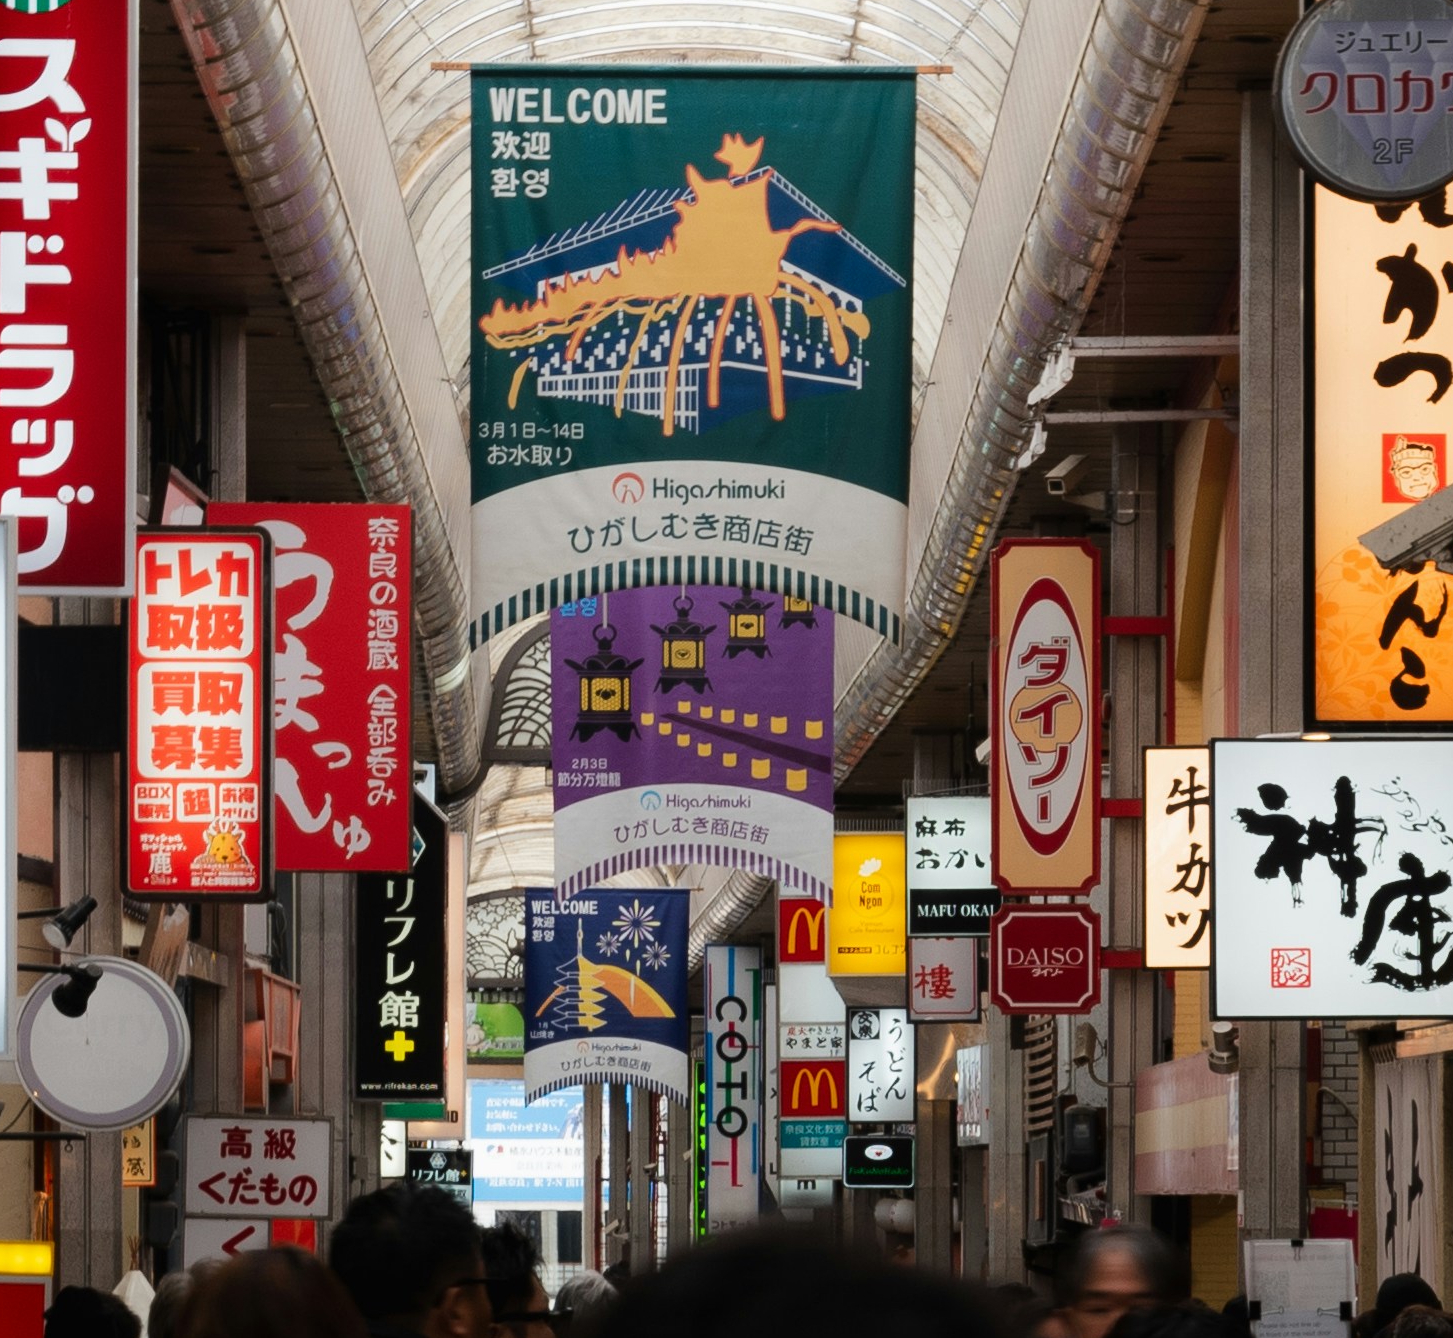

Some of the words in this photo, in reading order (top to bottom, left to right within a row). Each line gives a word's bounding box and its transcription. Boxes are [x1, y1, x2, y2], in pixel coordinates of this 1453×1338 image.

[1334, 30, 1449, 56] ジュエリー
[490, 88, 668, 124] WELCOME
[491, 131, 551, 161] 欢迎
[1372, 138, 1415, 165] 2F
[490, 167, 550, 199] 환영
[486, 443, 574, 467] お水取り
[652, 478, 786, 506] Higashimuki
[566, 512, 815, 558] ひがしむき商店街
[144, 549, 250, 598] トレカ
[367, 516, 400, 671] 奈良の酒蔵
[146, 604, 244, 651] 取扱
[151, 671, 244, 717] 買取
[1016, 636, 1074, 824] ダイソー
[151, 725, 244, 771] 募集
[571, 758, 608, 770] 2月3日
[137, 787, 171, 799] BOX
[665, 794, 752, 811] Higashimuki
[613, 817, 770, 846] ひがしむき商店街
[915, 815, 966, 838] 麻布
[859, 894, 883, 910] Ngon
[861, 881, 882, 895] Com
[531, 900, 599, 916] WELCOME
[917, 904, 958, 918] MAFU
[378, 877, 420, 1029] リフレ館
[1006, 947, 1084, 966] DAISO
[1031, 967, 1064, 977] ダイソー
[591, 1043, 642, 1053] Higashimuki
[884, 1018, 907, 1101] うどん
[560, 1055, 652, 1072] ひがしむき商店街
[715, 996, 748, 1138] COTO
[857, 1061, 880, 1113] そば
[220, 1127, 296, 1160] 高級
[198, 1168, 318, 1207] くだもの
